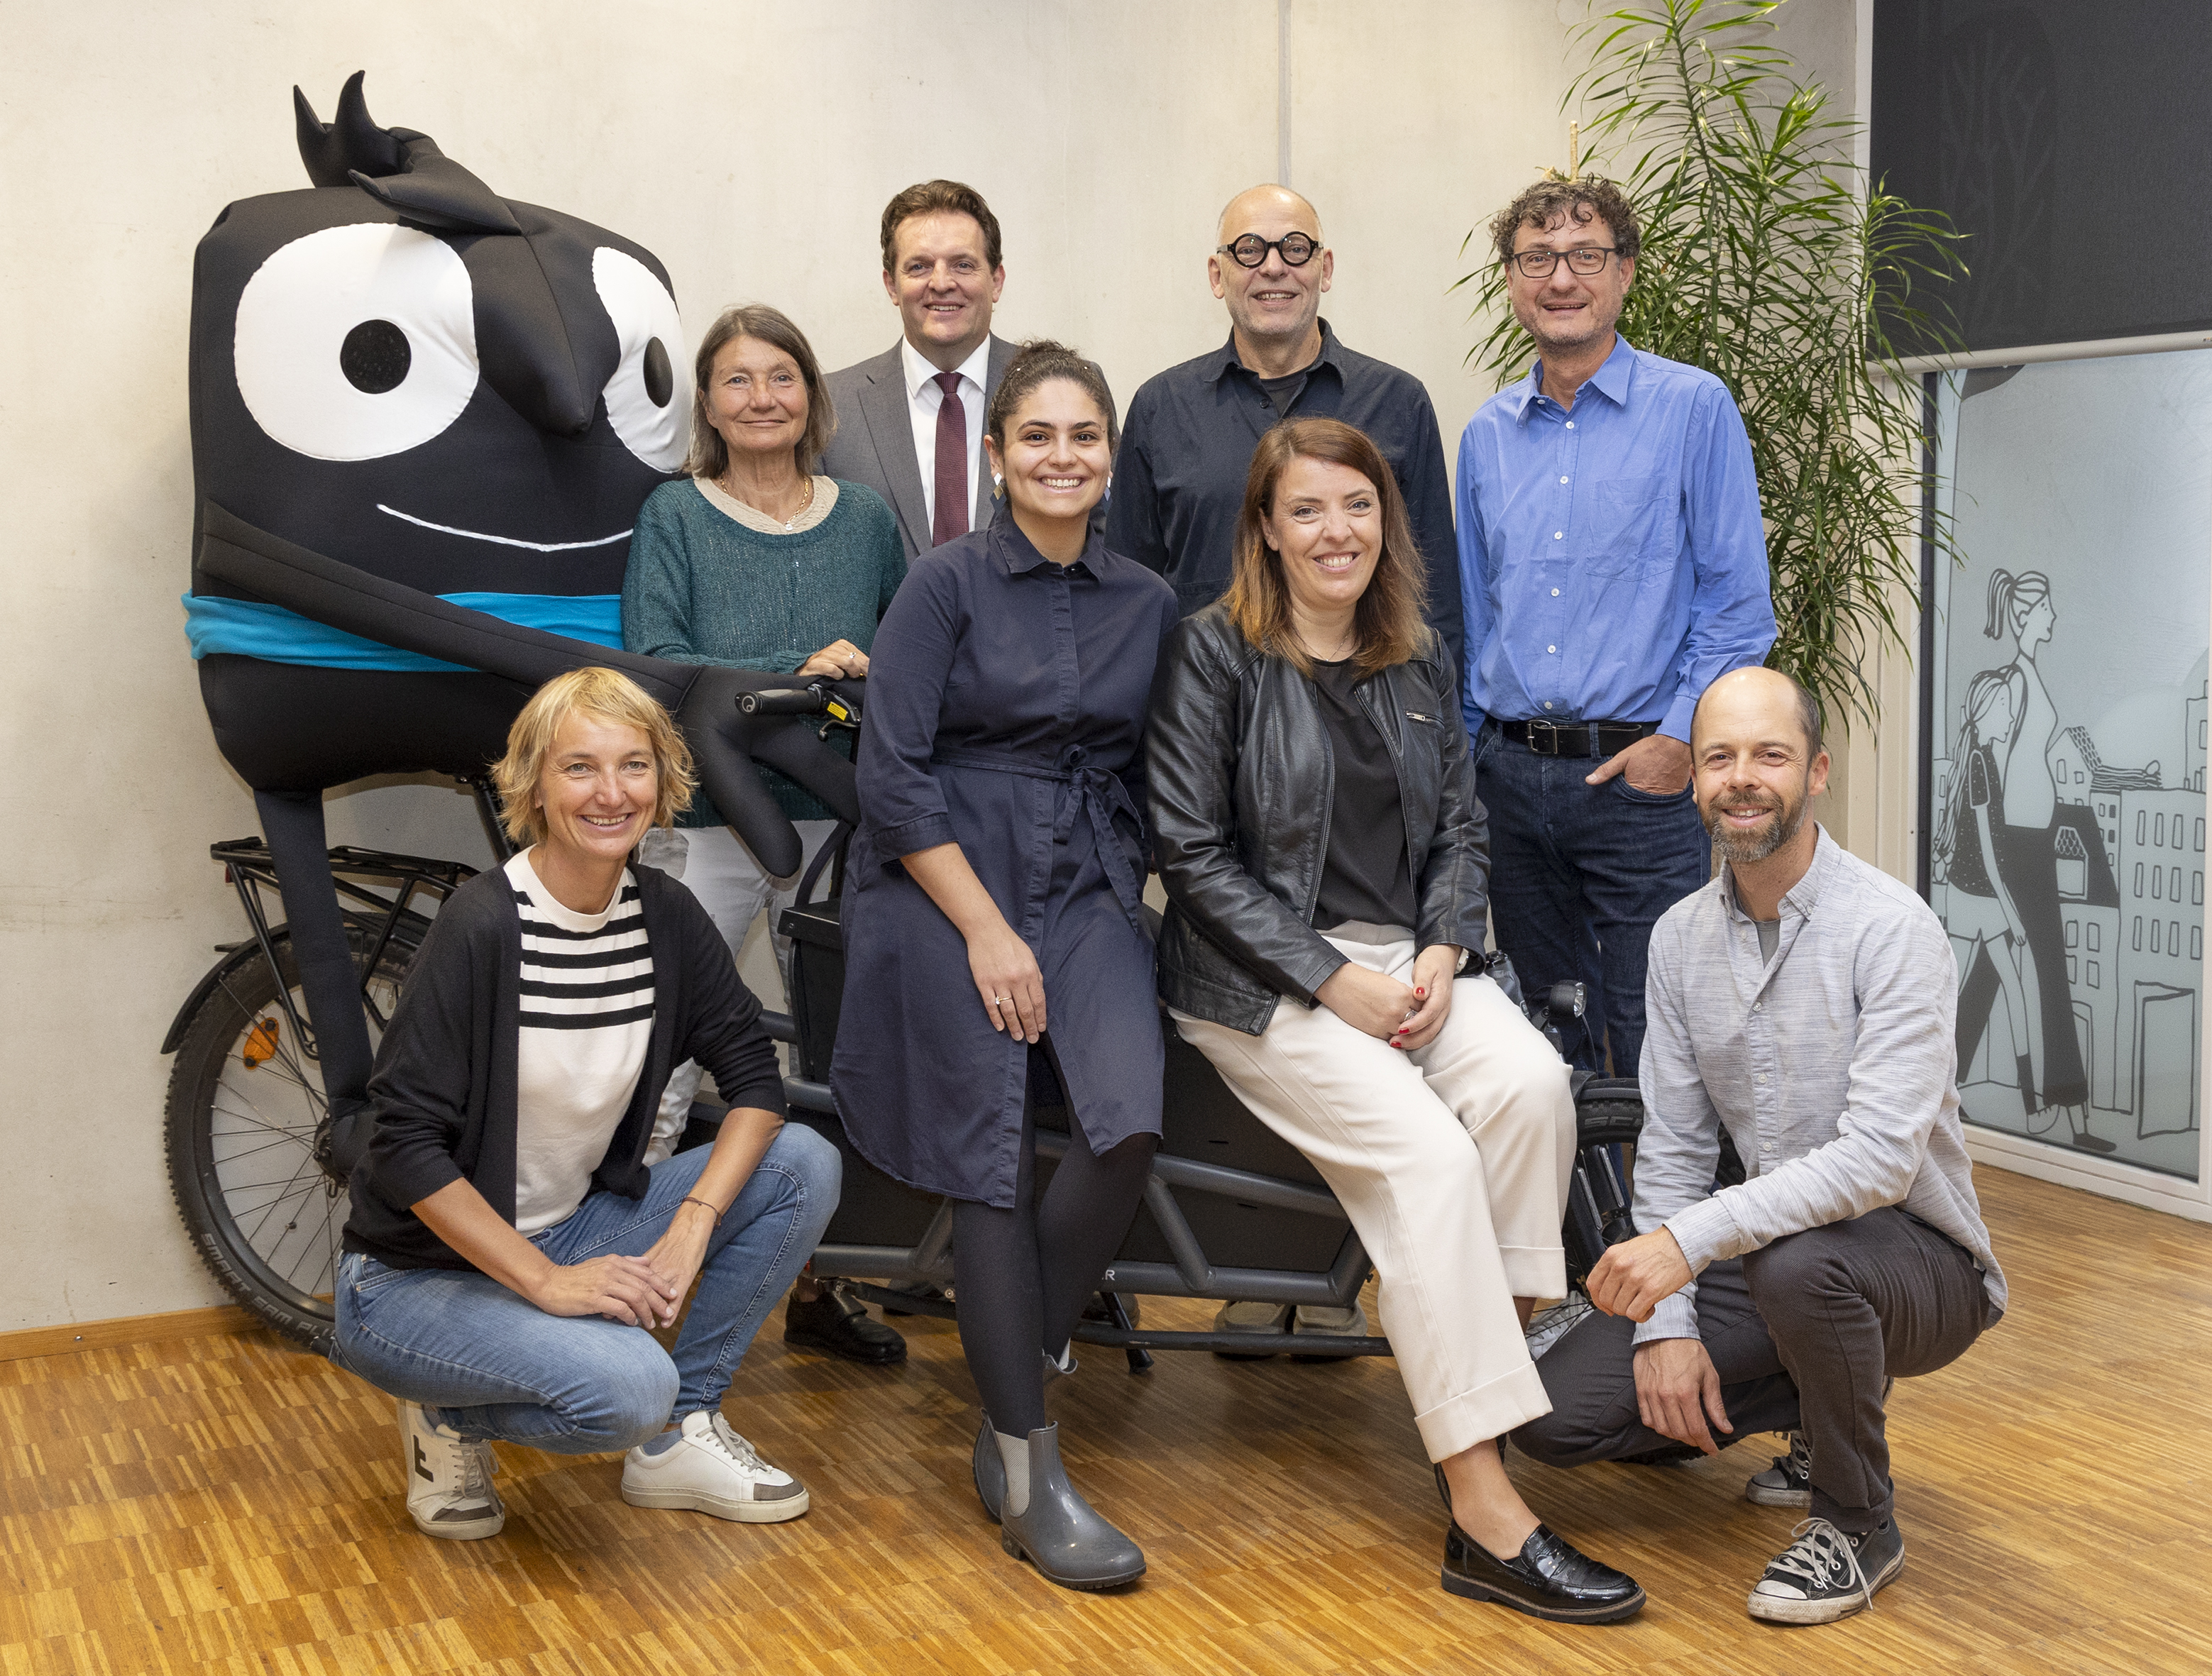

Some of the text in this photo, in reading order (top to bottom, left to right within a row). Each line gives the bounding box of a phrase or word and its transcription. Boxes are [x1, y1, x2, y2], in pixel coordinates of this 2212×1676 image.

[201, 1233, 251, 1291] SMART
[252, 1296, 292, 1325] SAM
[1101, 1269, 1116, 1281] R
